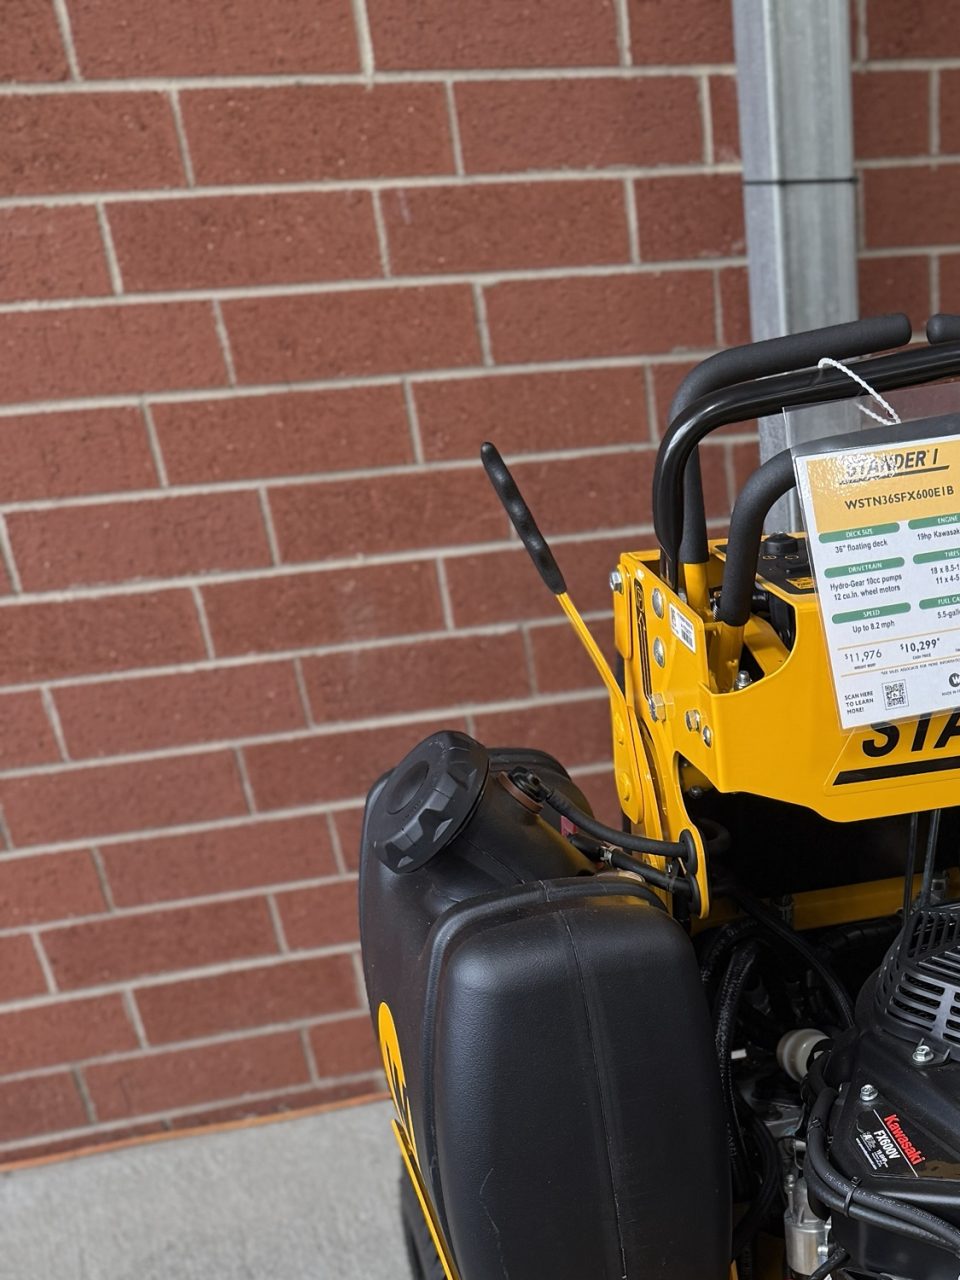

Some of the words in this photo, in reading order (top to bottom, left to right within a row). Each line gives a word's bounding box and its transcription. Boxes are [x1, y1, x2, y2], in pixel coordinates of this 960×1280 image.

[937, 515, 958, 524] ENGINE
[846, 540, 872, 553] floating
[872, 538, 888, 547] deck
[944, 549, 959, 557] TIRES
[848, 562, 882, 573] DRIVETRAIN
[830, 578, 865, 593] Hydro-Gear
[866, 576, 880, 585] 10cc
[881, 573, 902, 584] pumps
[949, 574, 960, 582] 4-5
[834, 593, 841, 601] 12
[860, 587, 878, 597] wheel
[879, 584, 900, 593] motors
[863, 609, 880, 617] SPEED
[852, 625, 861, 634] Up
[870, 622, 879, 630] 8.2
[880, 620, 895, 629] mph
[860, 690, 873, 698] HERE
[847, 706, 864, 714] MORE!
[874, 1130, 900, 1160] FX600V
[884, 1114, 925, 1166] Kawasaki
